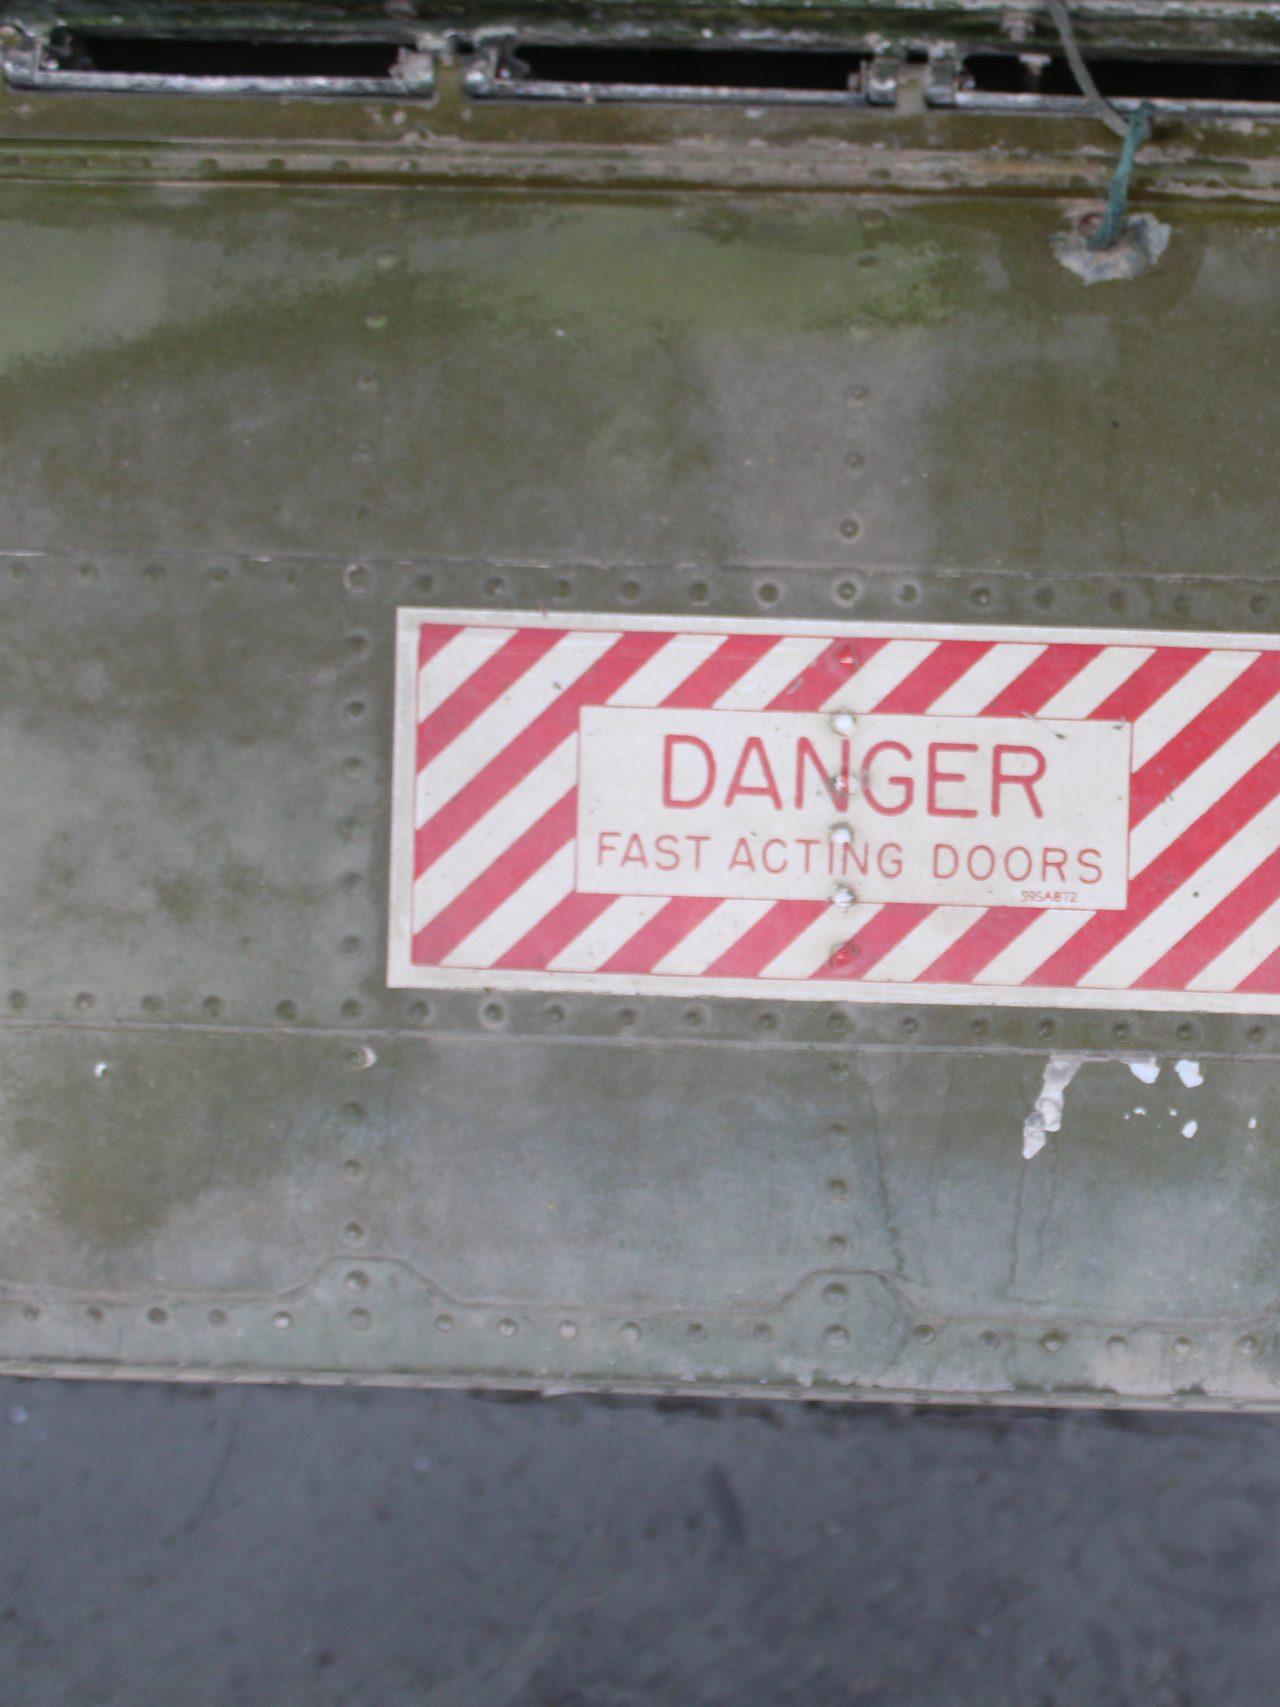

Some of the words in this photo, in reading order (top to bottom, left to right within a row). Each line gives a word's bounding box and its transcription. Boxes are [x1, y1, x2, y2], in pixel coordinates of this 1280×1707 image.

[662, 733, 1044, 819] DANGER
[595, 830, 712, 872] FAST
[729, 834, 904, 880] ACTING
[933, 844, 1104, 886] DOORS
